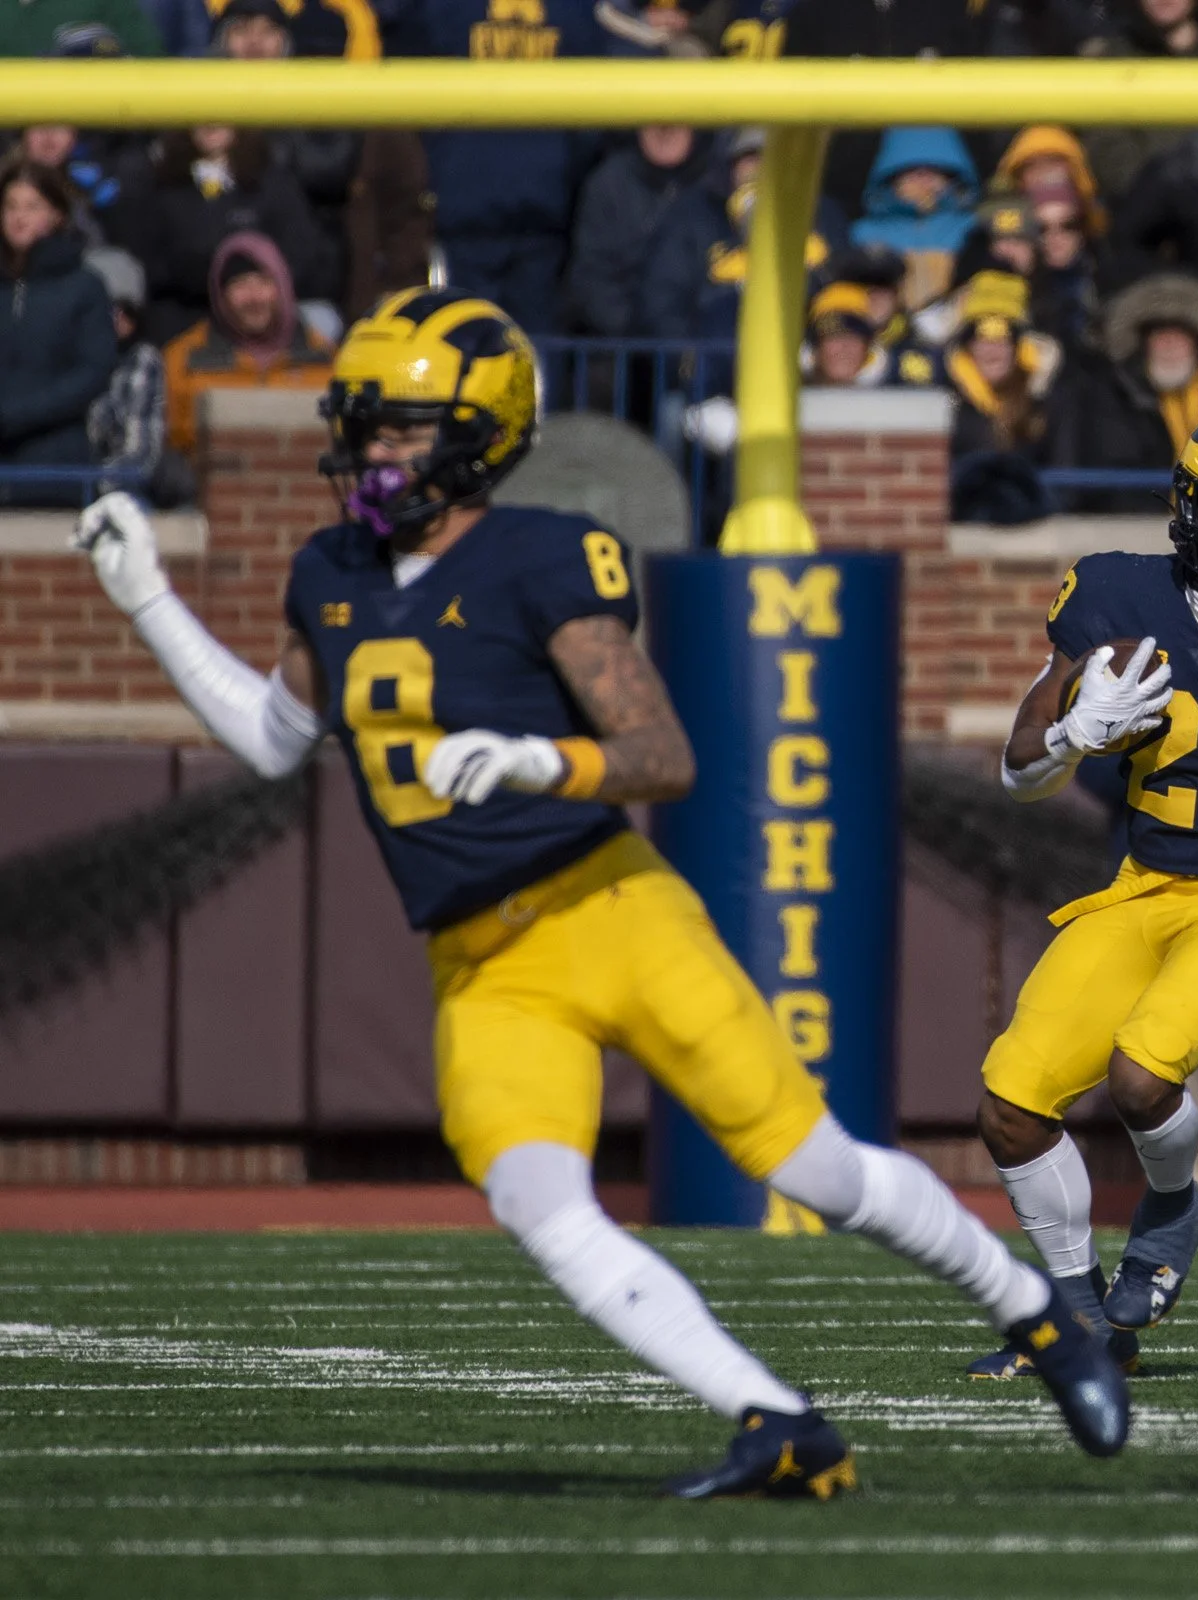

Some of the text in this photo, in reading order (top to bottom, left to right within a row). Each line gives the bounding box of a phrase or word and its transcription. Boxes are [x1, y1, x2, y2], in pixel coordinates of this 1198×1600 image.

[582, 530, 630, 600] 8
[342, 636, 454, 828] 8
[748, 563, 842, 1235] MICHIG
